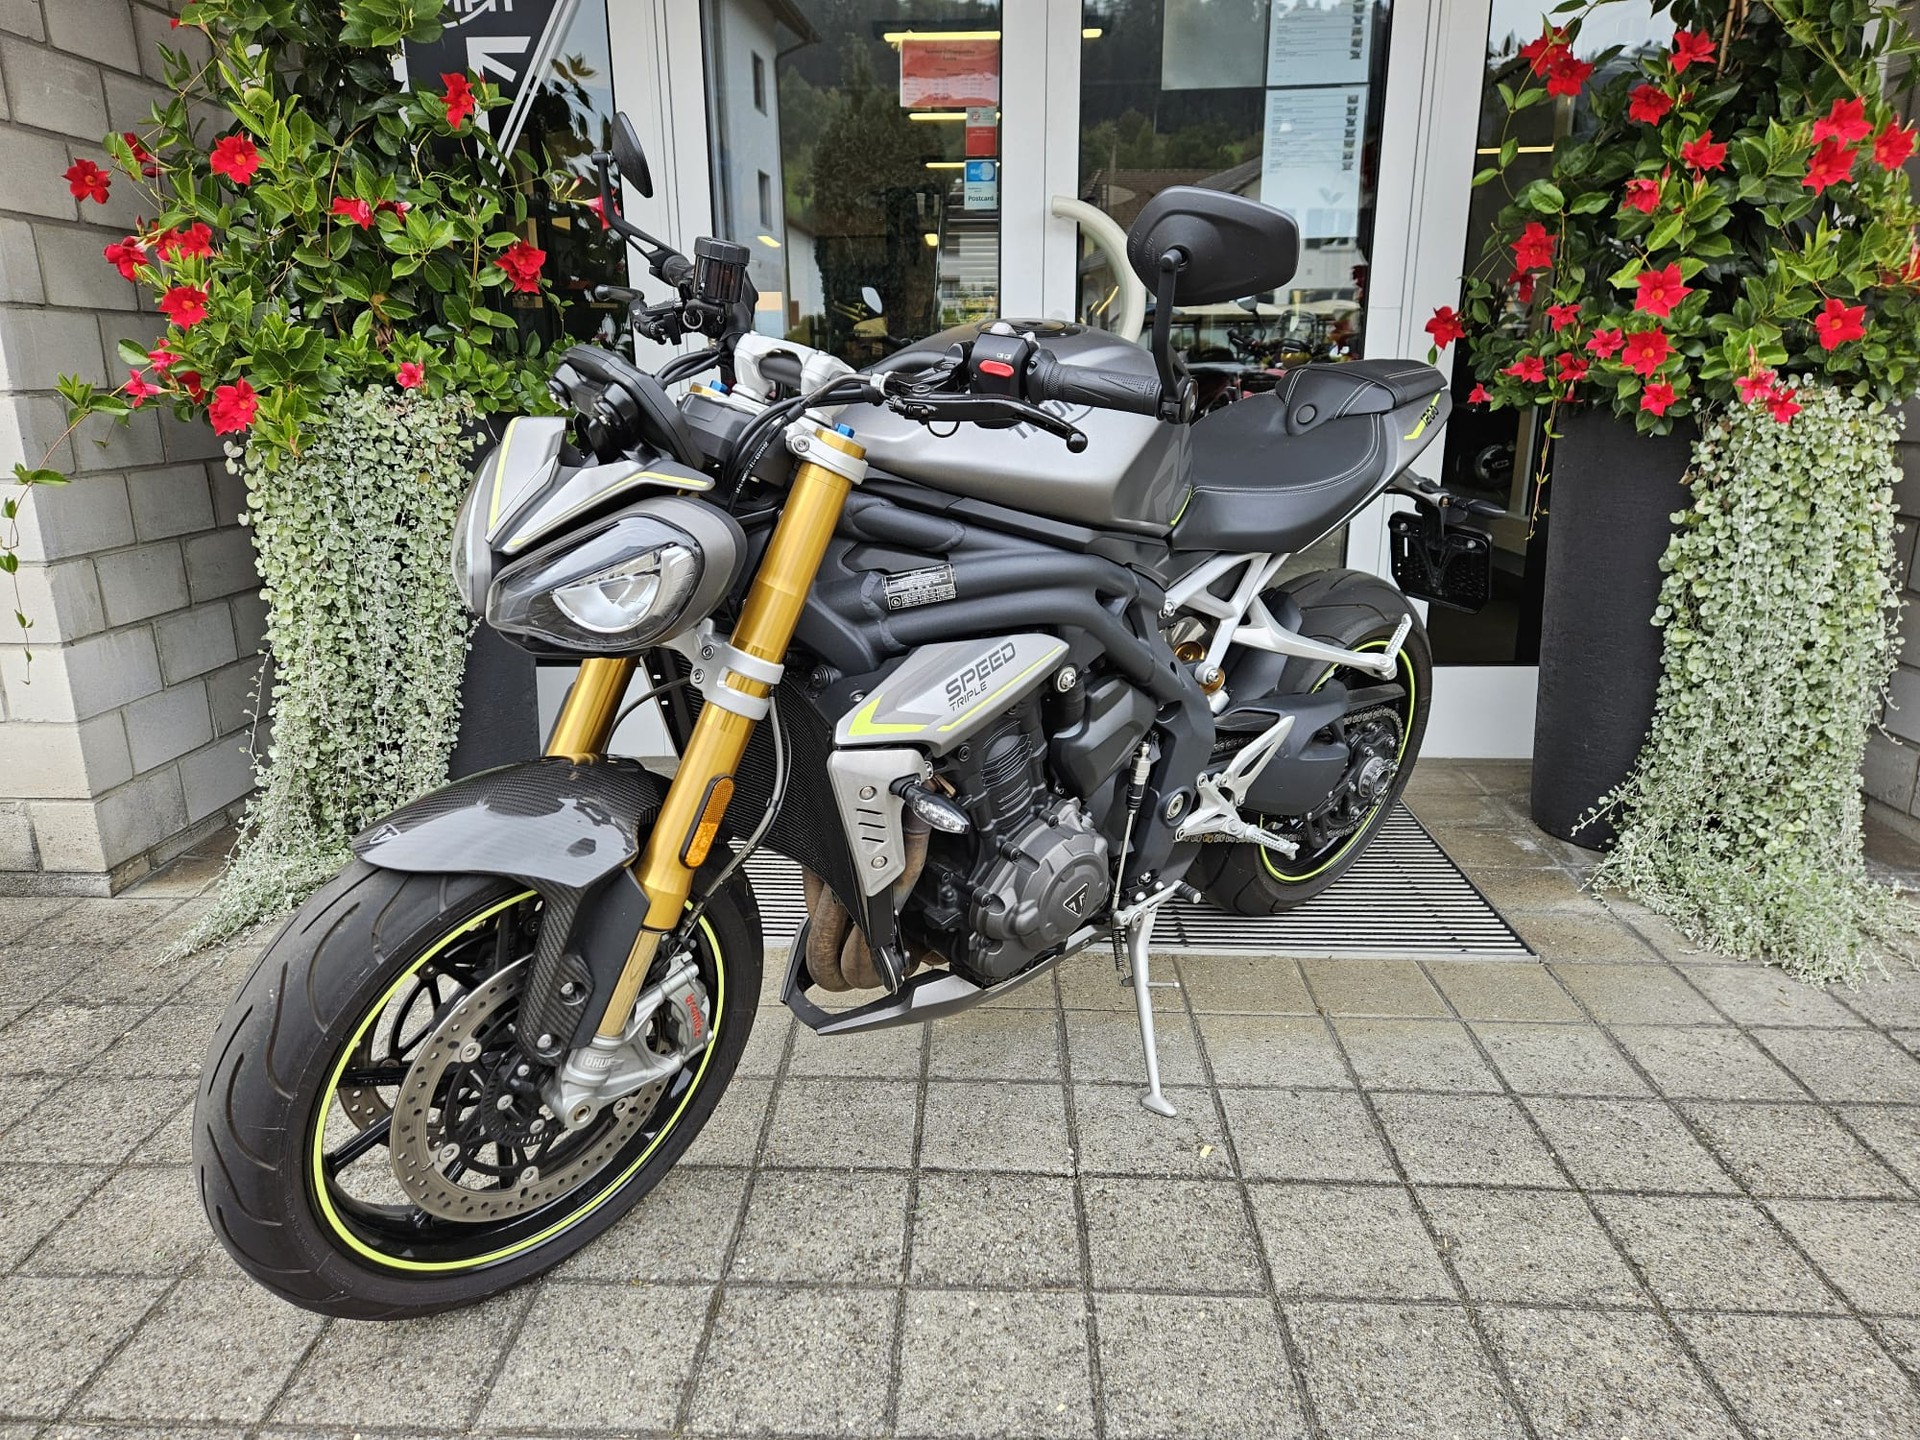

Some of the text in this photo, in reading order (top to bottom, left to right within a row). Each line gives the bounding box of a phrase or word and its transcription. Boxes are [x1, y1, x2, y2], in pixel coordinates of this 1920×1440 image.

[945, 642, 1016, 702] SPEED
[949, 681, 988, 712] TRIPLE
[685, 992, 704, 1039] brembo
